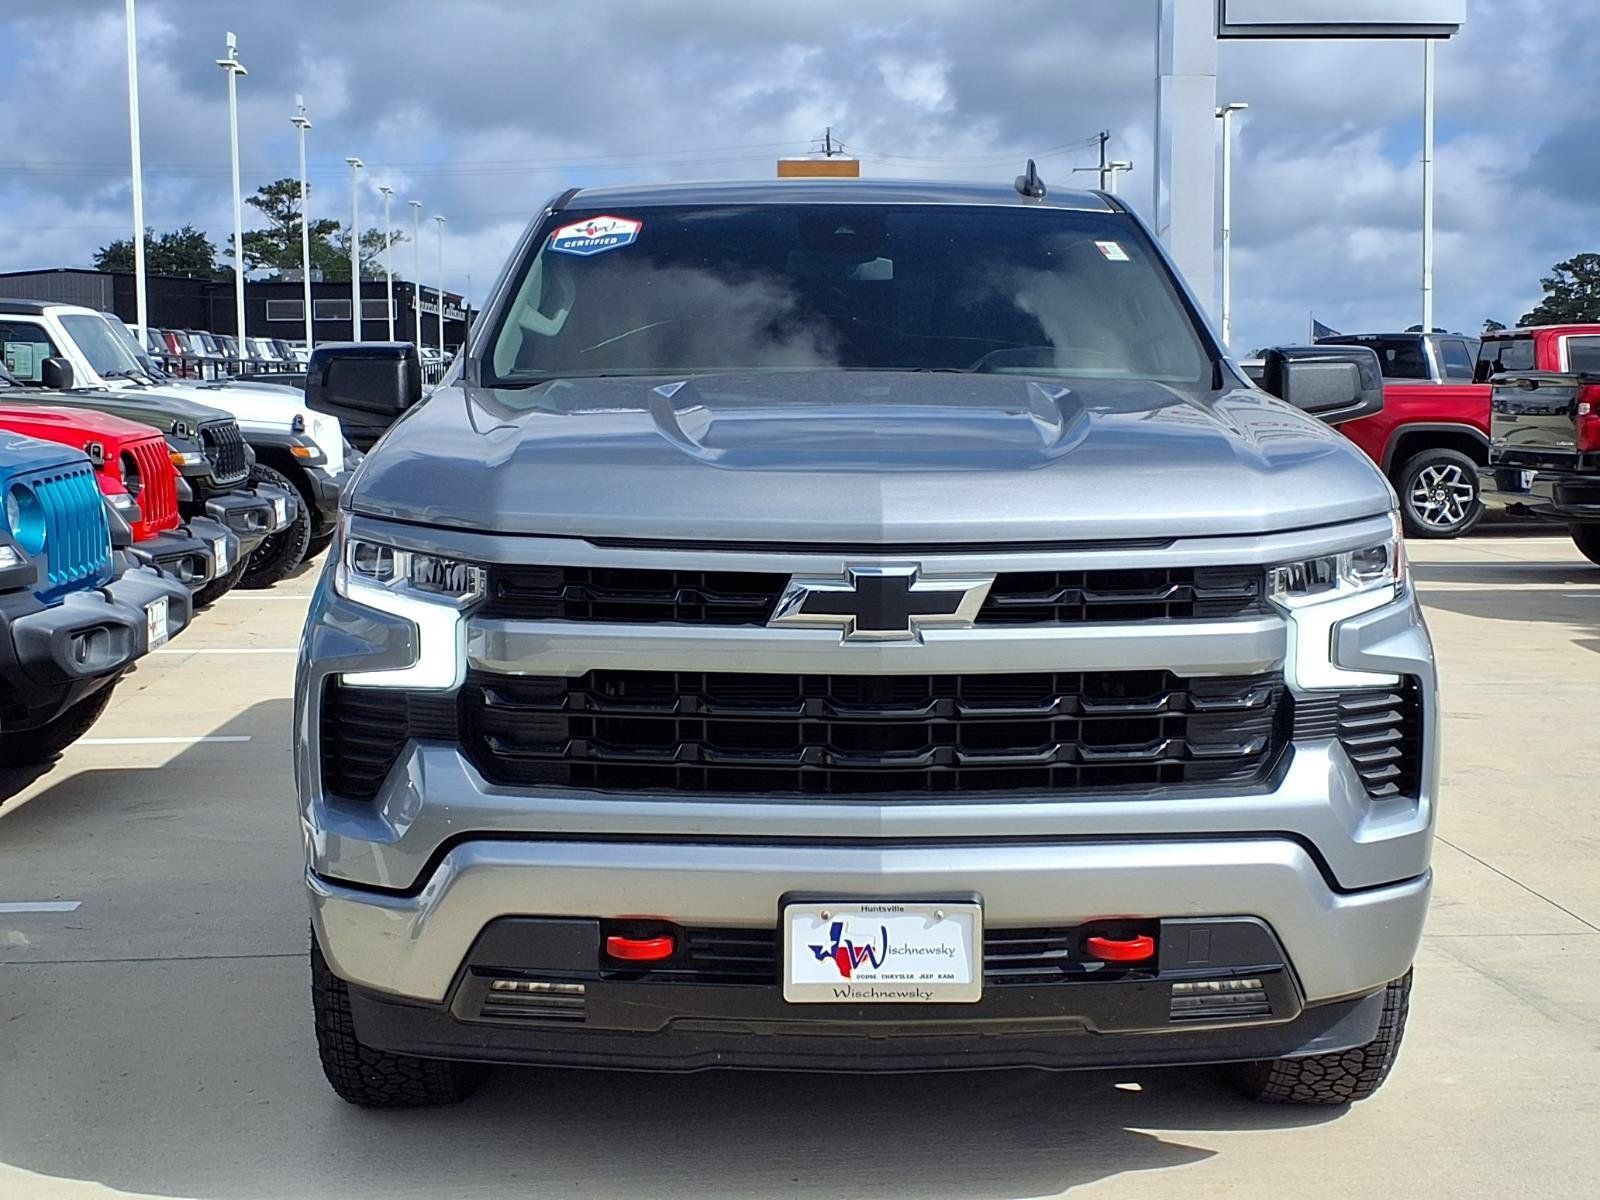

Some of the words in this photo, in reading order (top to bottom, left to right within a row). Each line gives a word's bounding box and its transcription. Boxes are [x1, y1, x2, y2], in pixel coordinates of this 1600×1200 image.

[563, 237, 618, 248] CERTIFIED
[860, 904, 905, 913] Huntsville
[832, 984, 934, 1000] Wischnewsky
